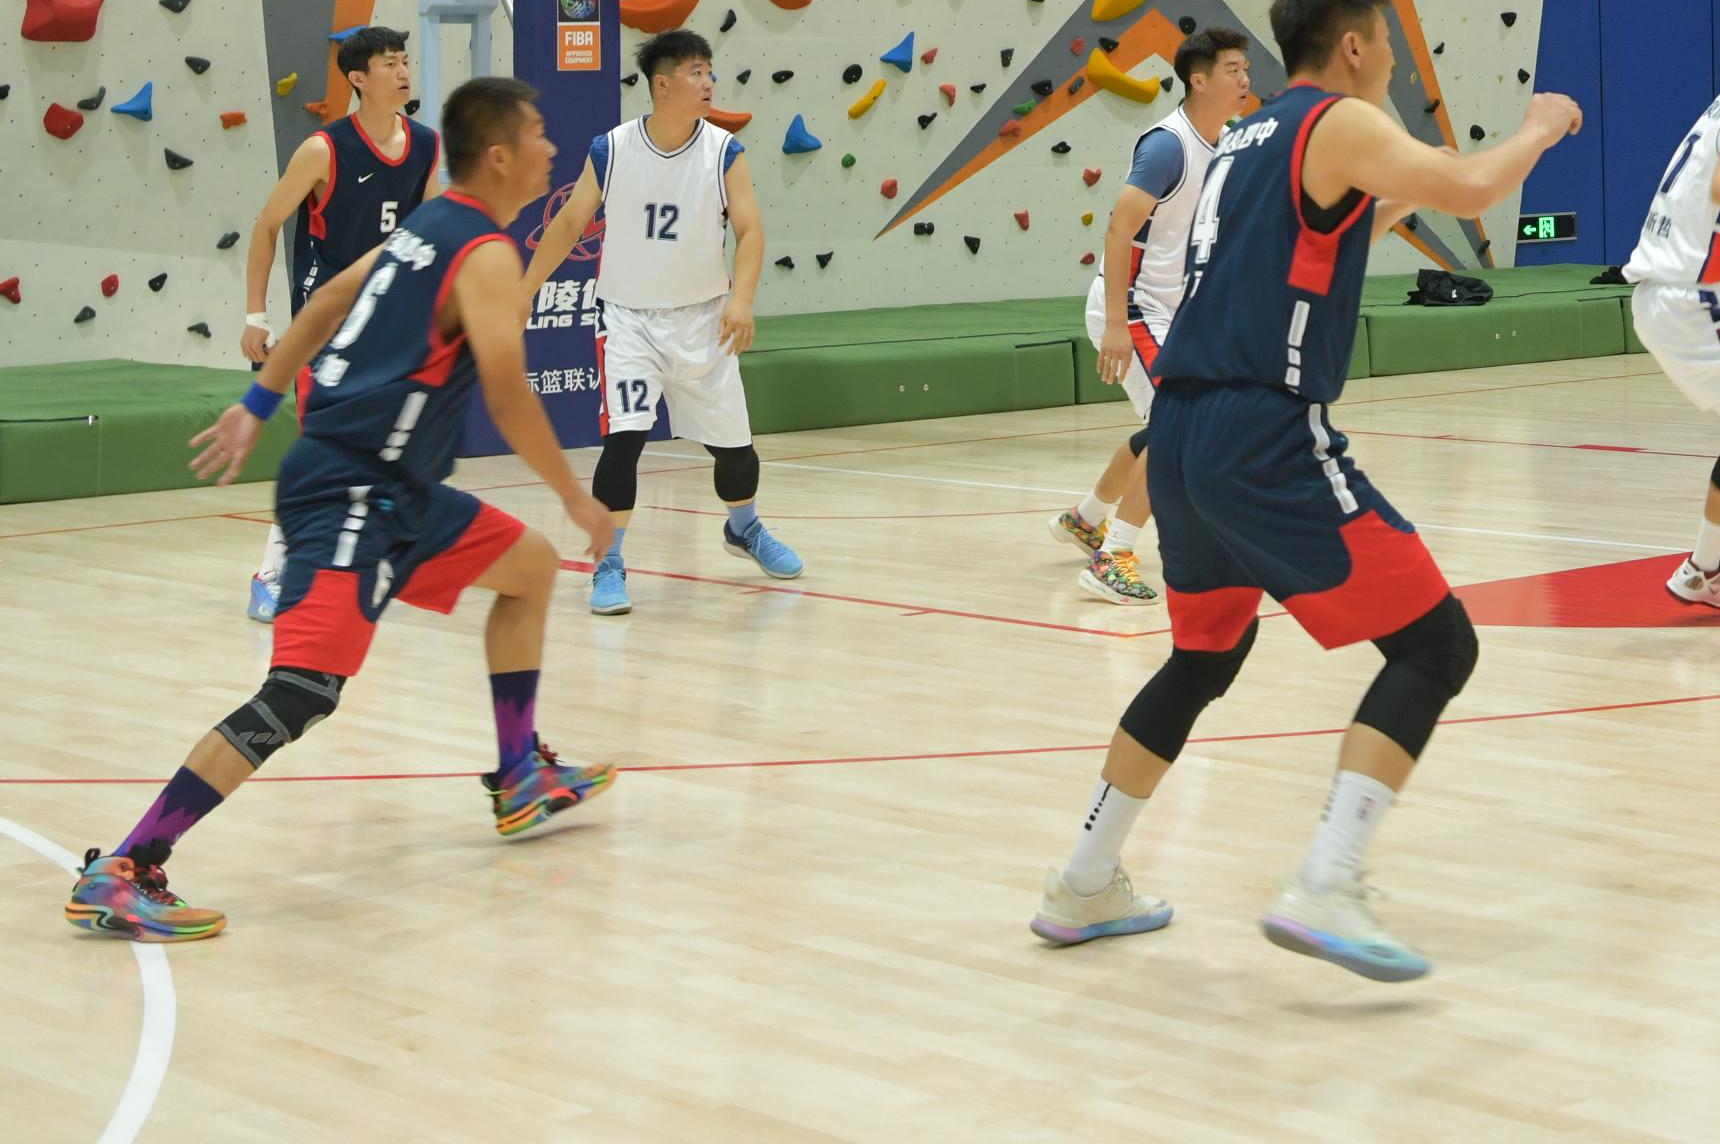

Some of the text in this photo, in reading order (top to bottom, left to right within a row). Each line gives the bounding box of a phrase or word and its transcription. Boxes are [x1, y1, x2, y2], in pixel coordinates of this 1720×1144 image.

[564, 31, 593, 46] FIBA
[380, 200, 399, 234] 5
[643, 201, 681, 242] 12
[1190, 155, 1235, 264] 4
[580, 312, 598, 327] S
[616, 378, 651, 414] 12
